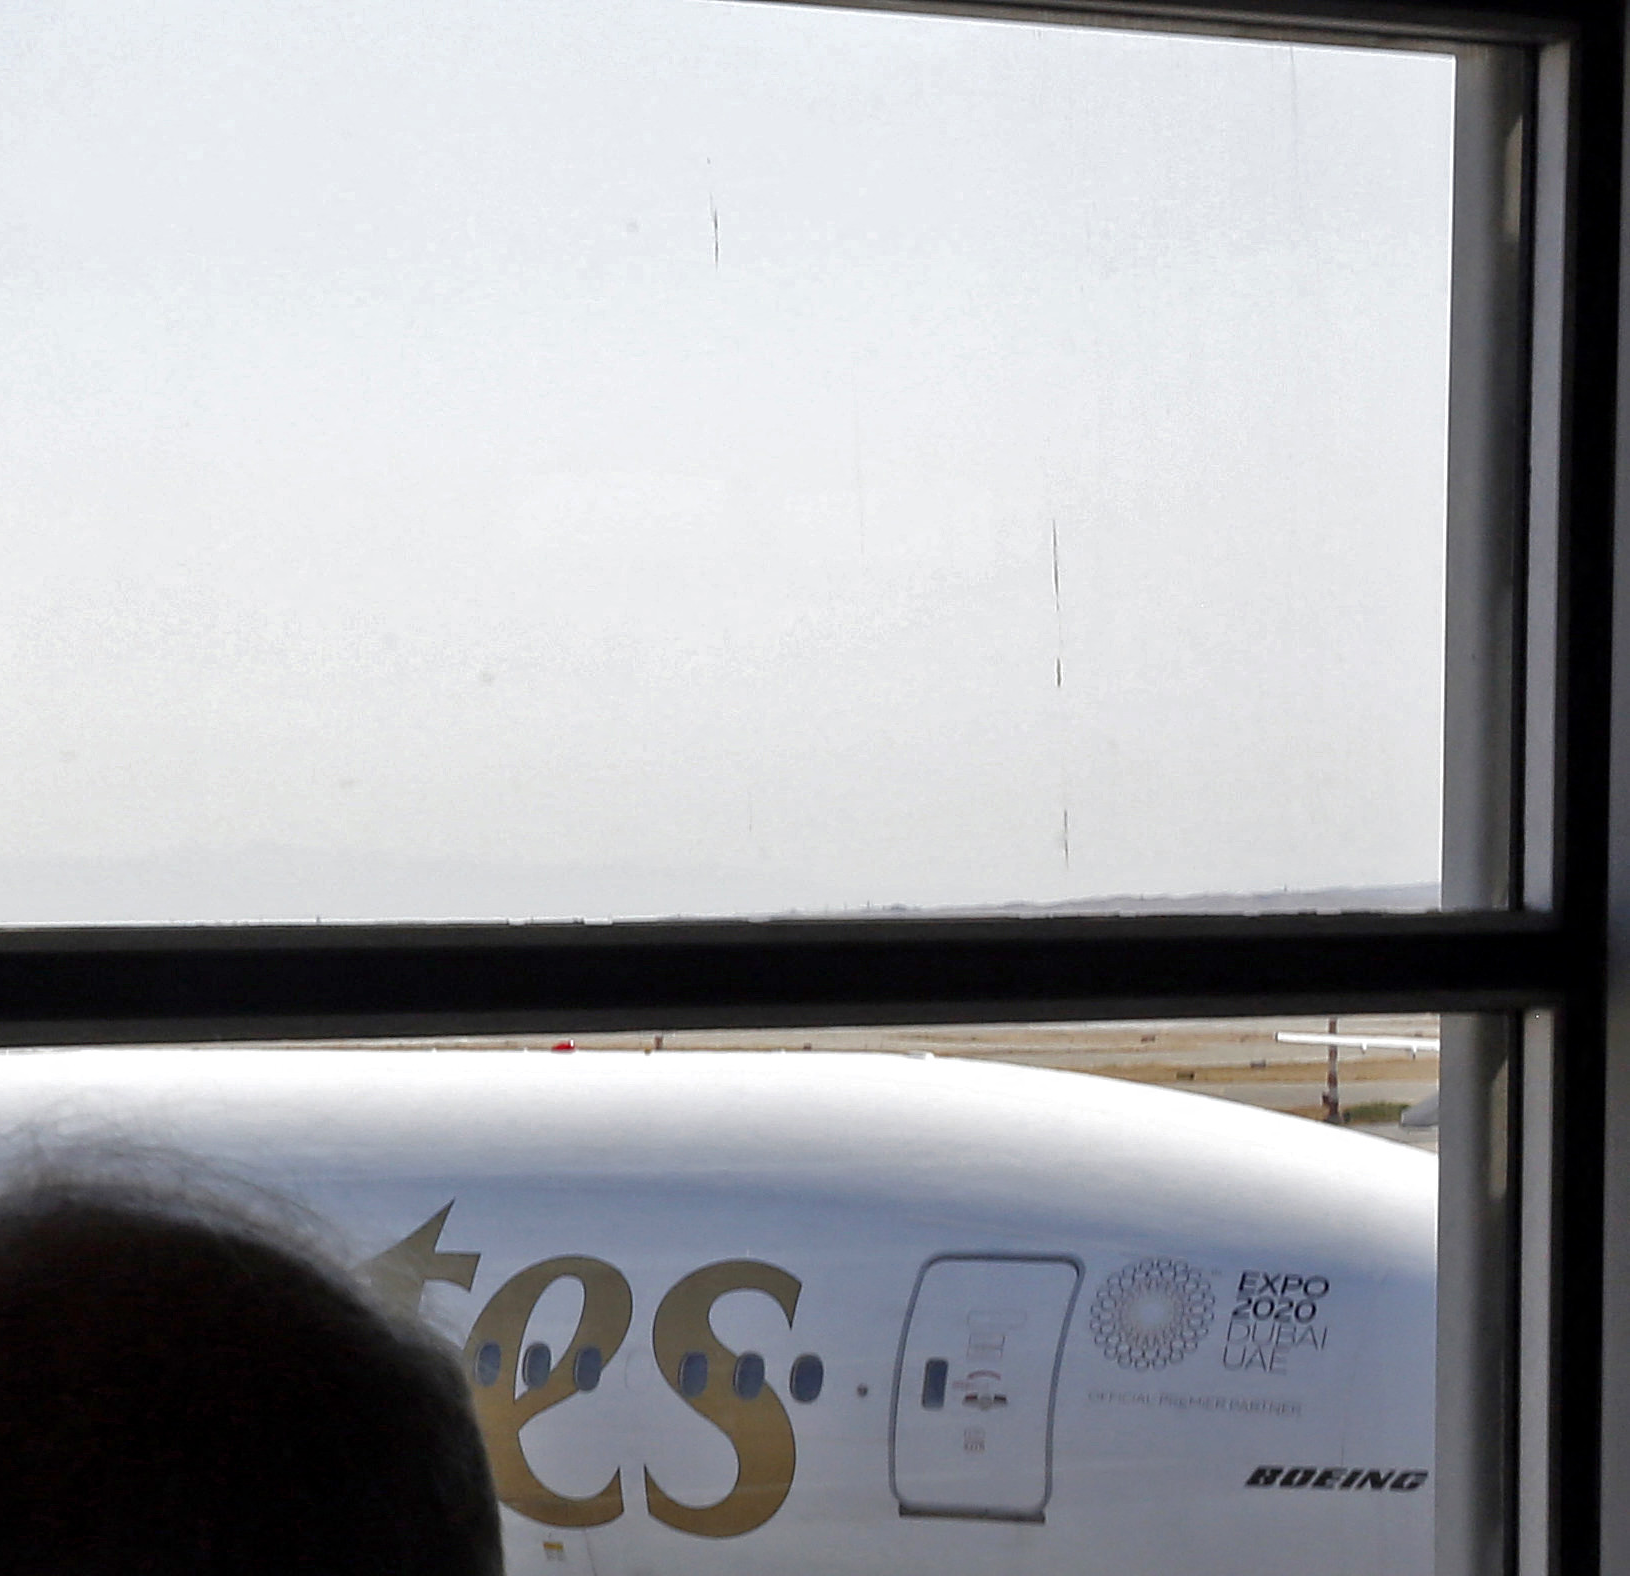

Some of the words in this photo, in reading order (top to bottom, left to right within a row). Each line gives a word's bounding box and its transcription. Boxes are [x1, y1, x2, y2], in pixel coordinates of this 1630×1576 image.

[1238, 1270, 1331, 1299] EXPO
[1231, 1298, 1318, 1324] 2020
[1226, 1321, 1329, 1351] DUBAI
[1222, 1346, 1289, 1375] UAE
[1244, 1465, 1430, 1491] BOEING
